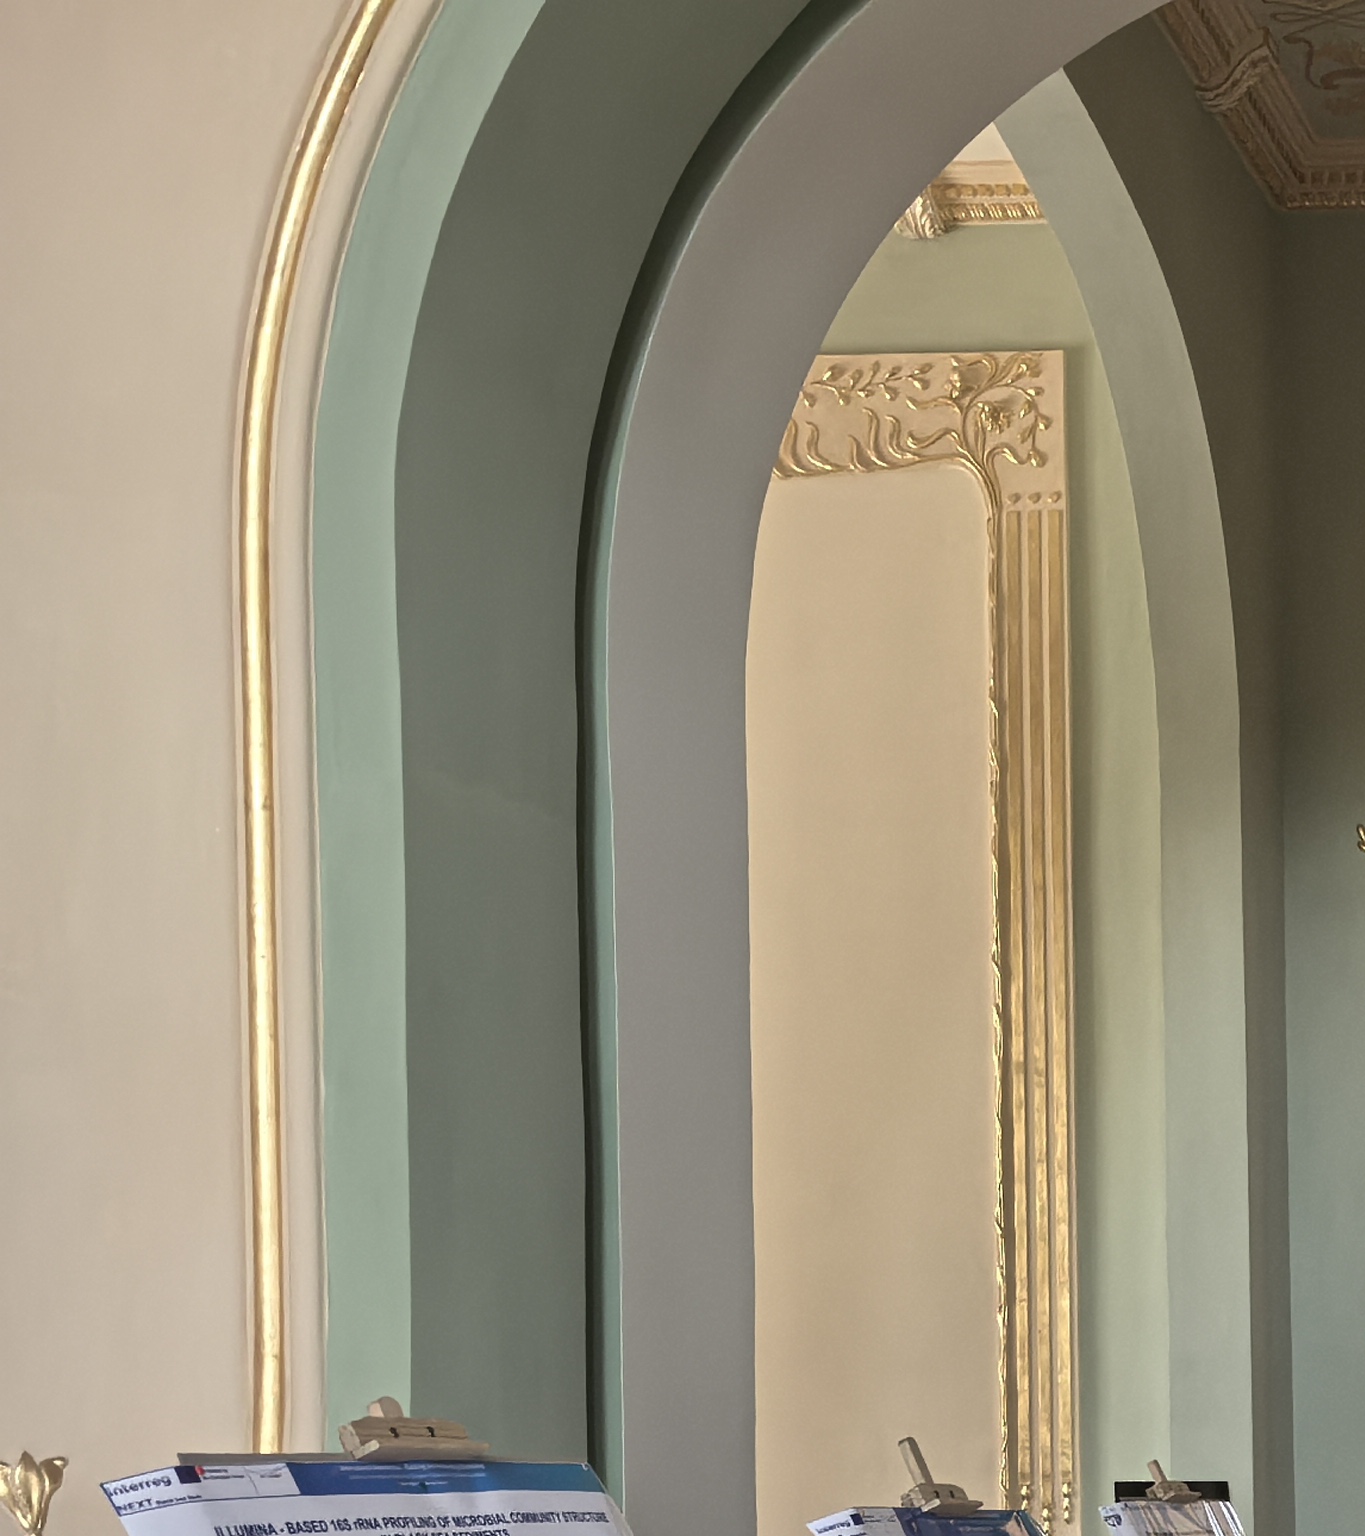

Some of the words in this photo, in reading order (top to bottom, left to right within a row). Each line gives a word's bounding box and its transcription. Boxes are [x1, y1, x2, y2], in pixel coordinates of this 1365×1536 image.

[108, 1475, 172, 1498] Interreg
[286, 1520, 328, 1534] BASED
[330, 1518, 351, 1532] 16S
[354, 1517, 382, 1530] rRNA
[382, 1514, 437, 1529] PROFILING
[438, 1514, 451, 1528] OF
[452, 1512, 510, 1528] MICROBIAL
[510, 1511, 562, 1524] COMMUNITY
[562, 1511, 610, 1523] STRUCTURE
